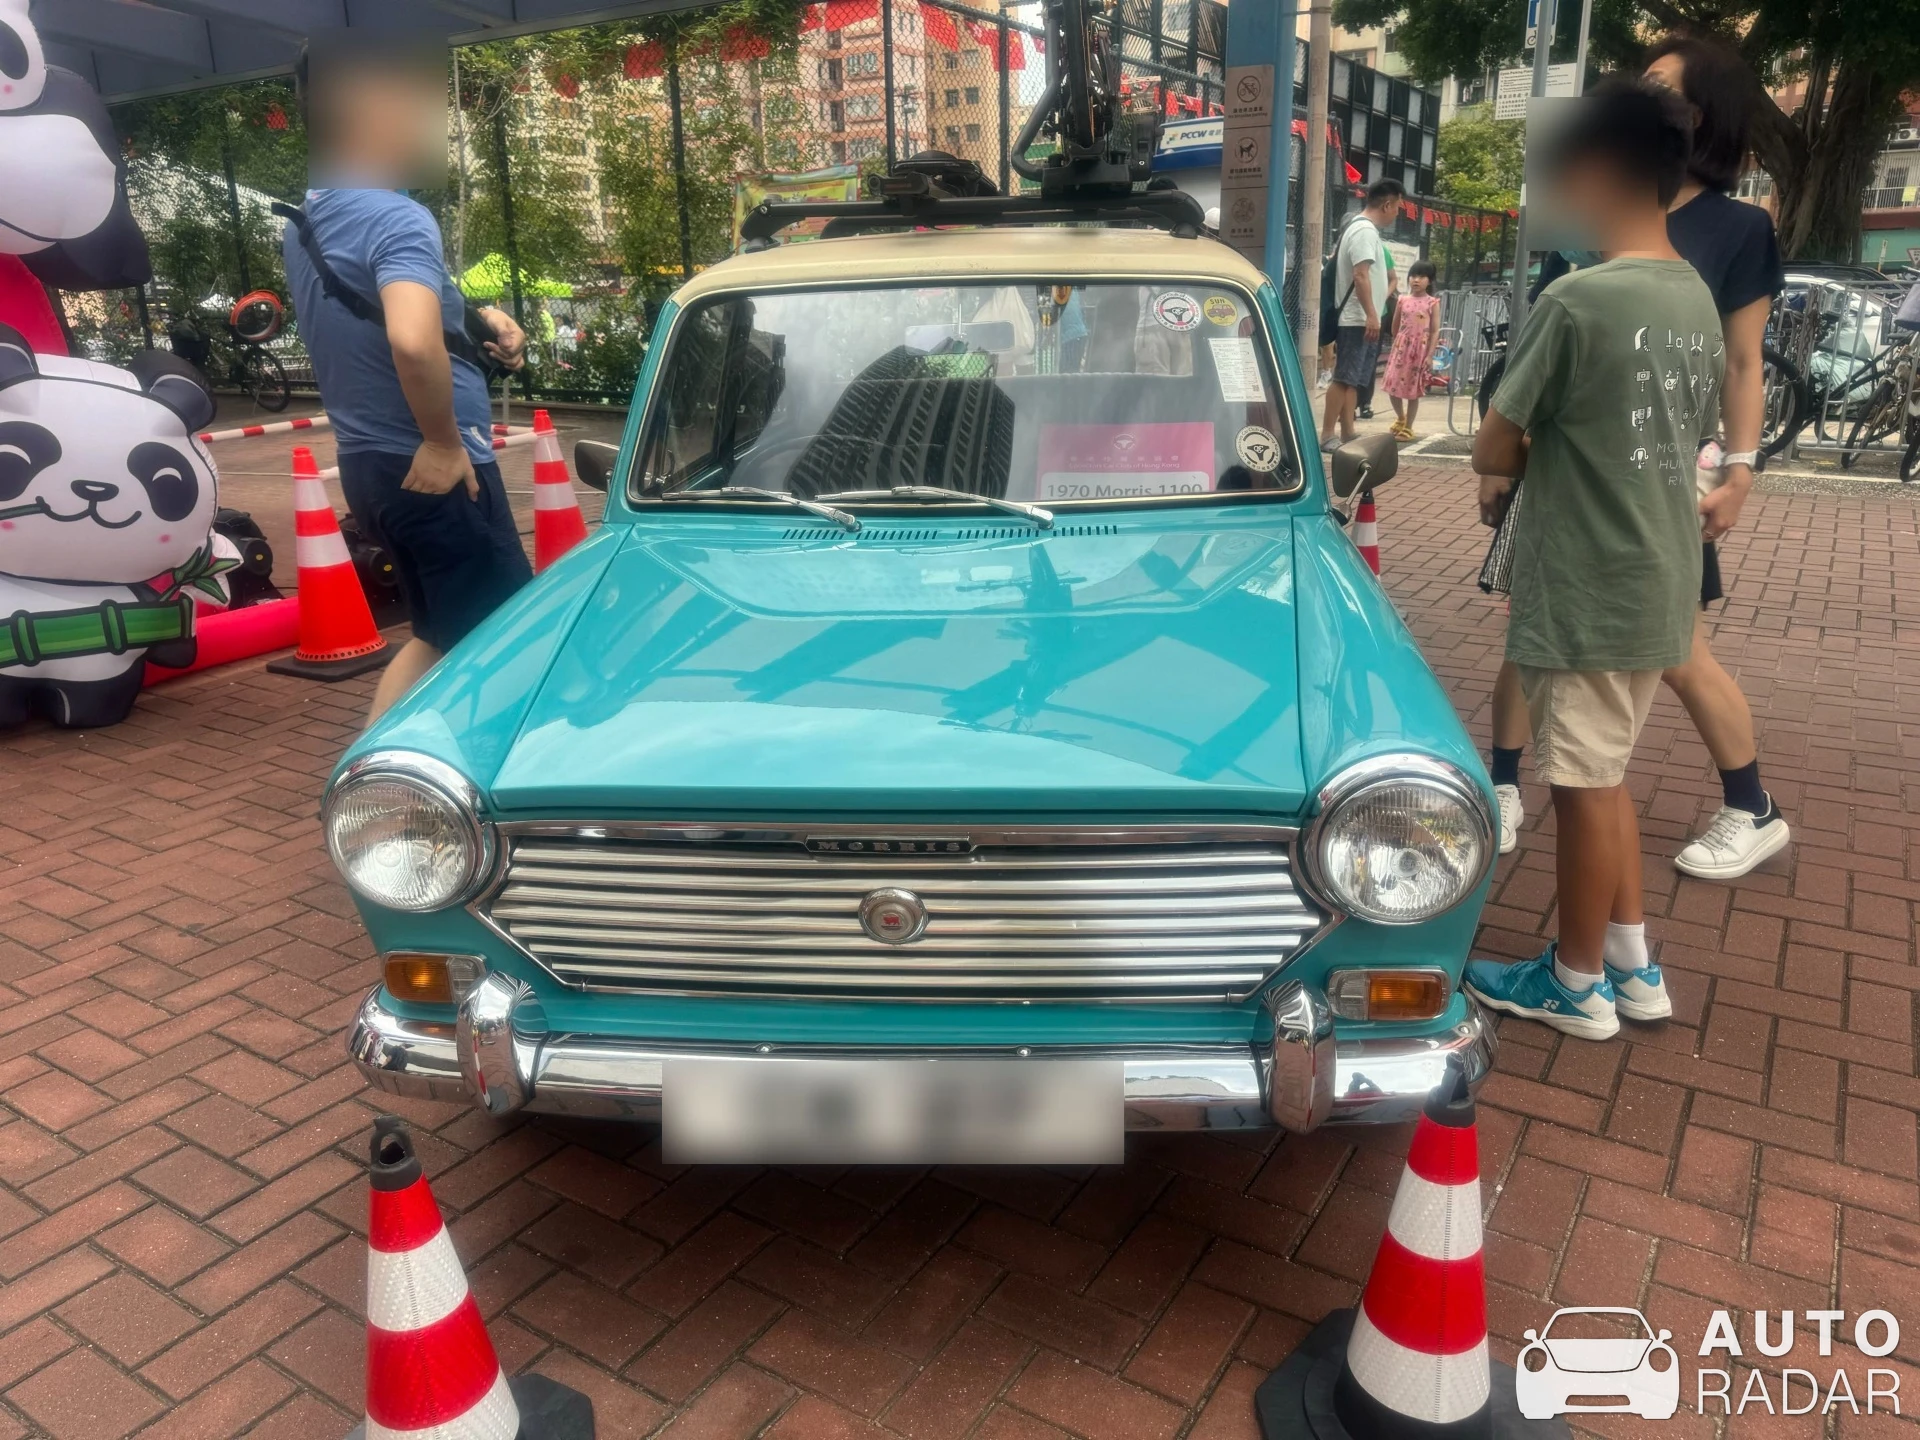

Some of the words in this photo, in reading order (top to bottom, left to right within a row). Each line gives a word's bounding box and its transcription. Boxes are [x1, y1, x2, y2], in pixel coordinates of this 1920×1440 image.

[1180, 130, 1207, 140] PCCW
[1161, 461, 1180, 470] Kong
[1047, 484, 1090, 498] 1970
[1095, 484, 1152, 498] Morris
[1158, 483, 1203, 494] 1100
[817, 841, 961, 852] MORRIS
